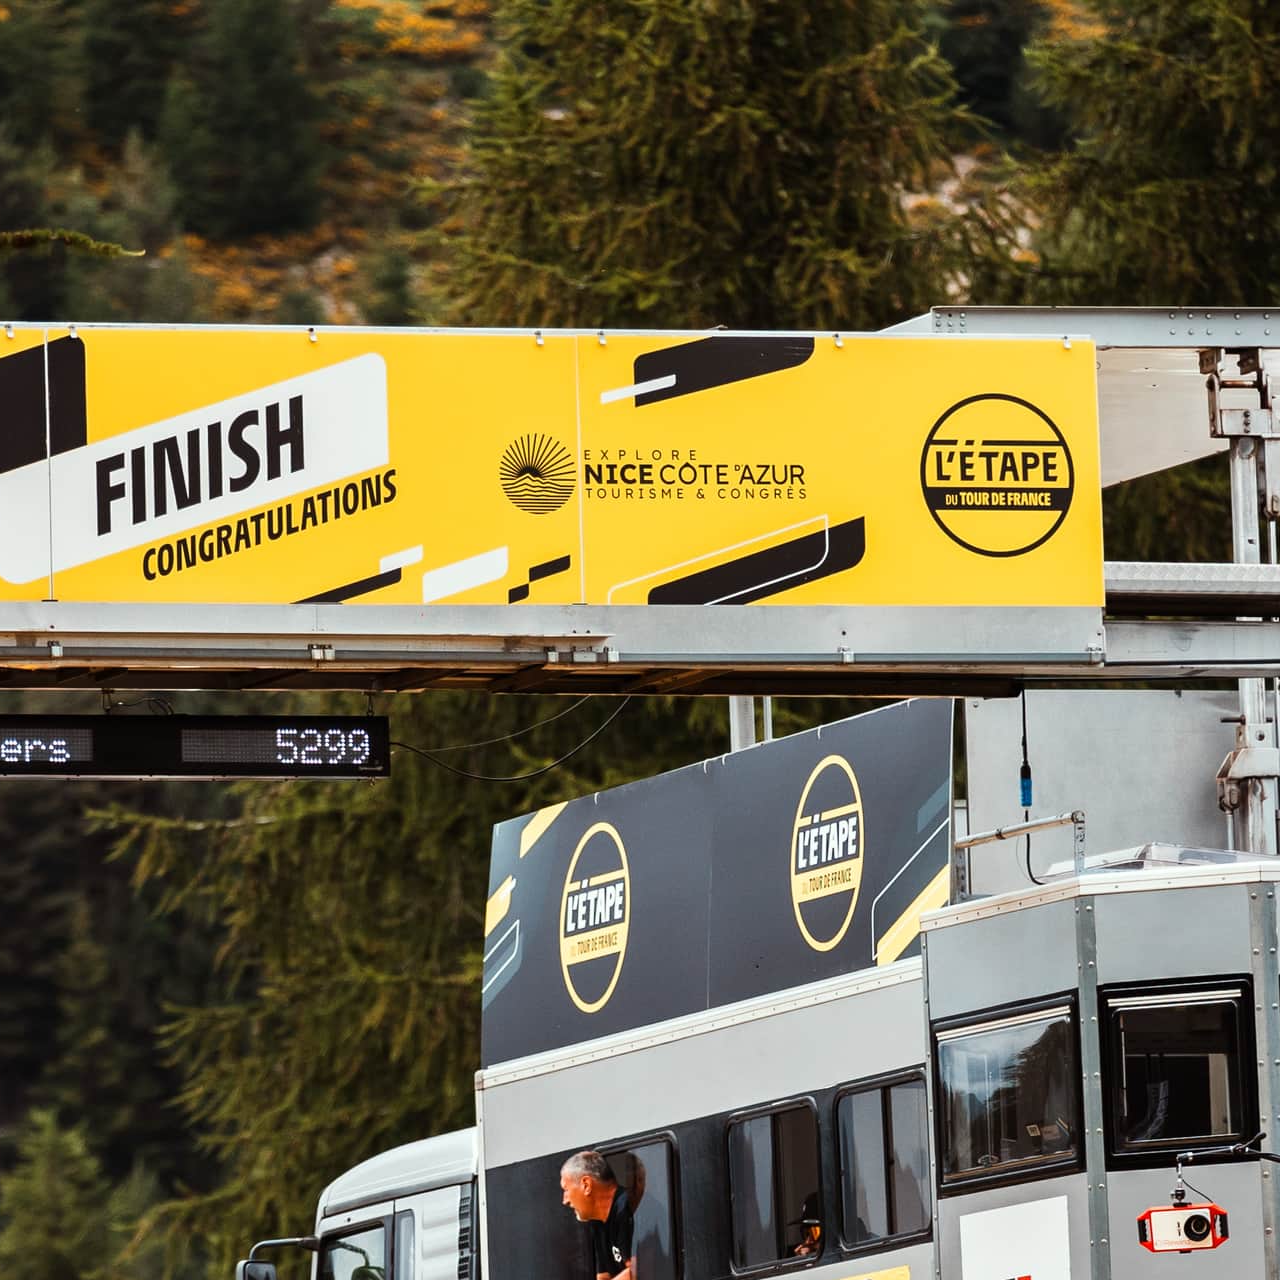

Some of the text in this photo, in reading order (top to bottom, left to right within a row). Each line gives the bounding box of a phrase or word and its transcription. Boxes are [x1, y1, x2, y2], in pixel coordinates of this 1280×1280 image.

[96, 394, 305, 536] FINISH
[584, 450, 697, 461] EXPLORE
[584, 462, 806, 486] NICE CÔTE D'AZUR
[585, 486, 808, 500] TOURISME & CONGRÈS
[945, 492, 1052, 507] DU TOUR DE FRANCE
[142, 469, 397, 581] CONGRATULATIONS
[275, 728, 371, 764] 5299
